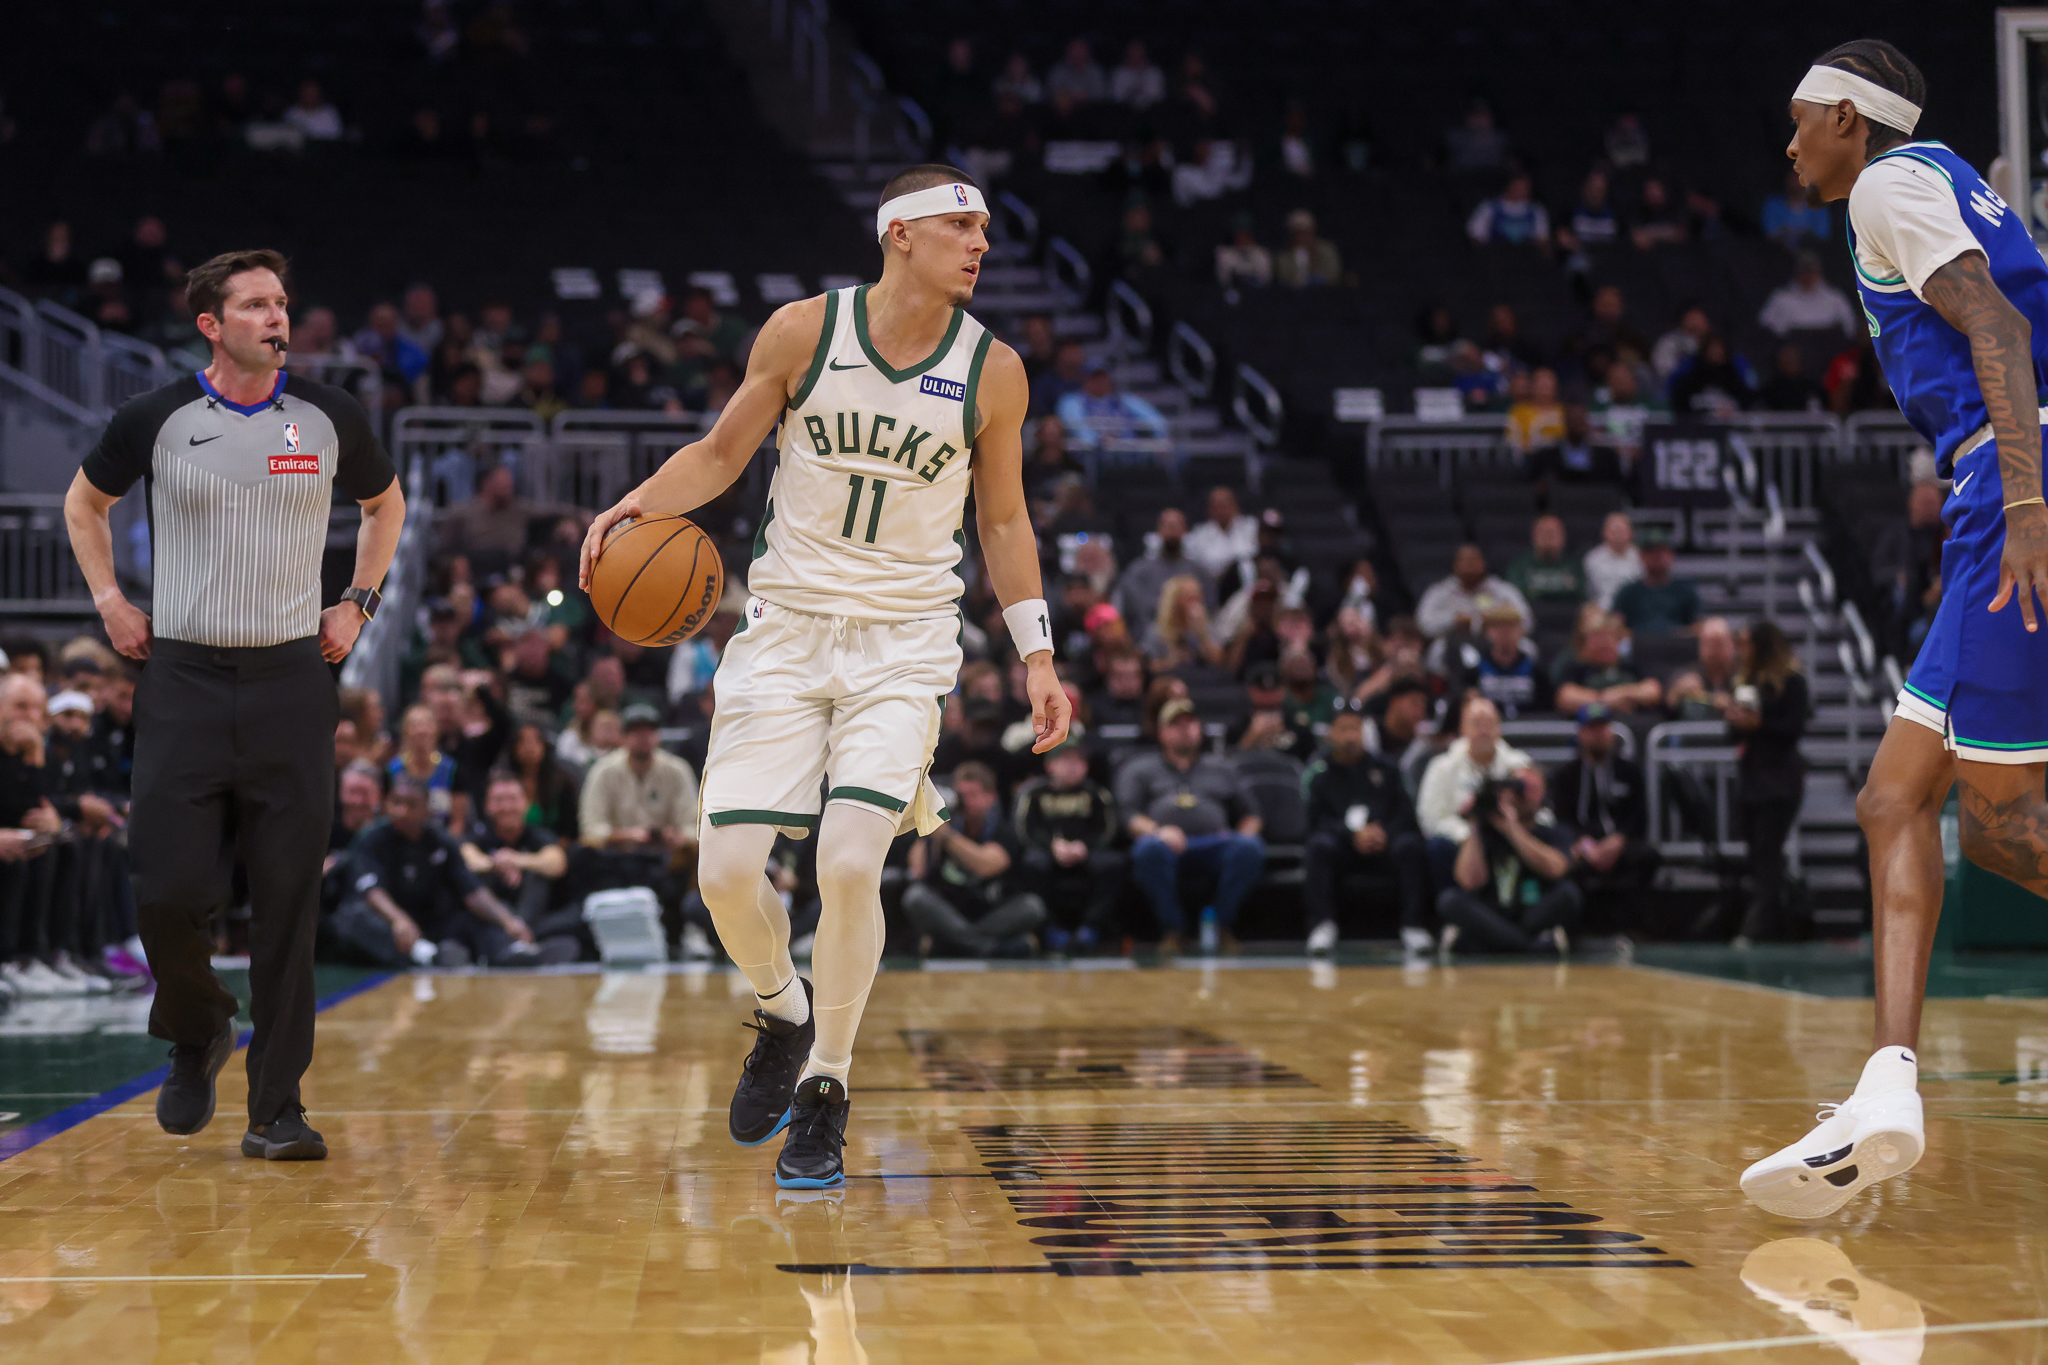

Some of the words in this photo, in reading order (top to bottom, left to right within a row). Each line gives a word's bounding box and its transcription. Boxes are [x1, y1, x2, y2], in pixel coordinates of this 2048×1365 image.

[923, 378, 963, 398] ULINE
[269, 458, 319, 471] Emirates
[804, 412, 957, 483] BUCKS
[1653, 439, 1718, 490] 122
[842, 474, 887, 544] 11
[655, 574, 716, 645] Wilson
